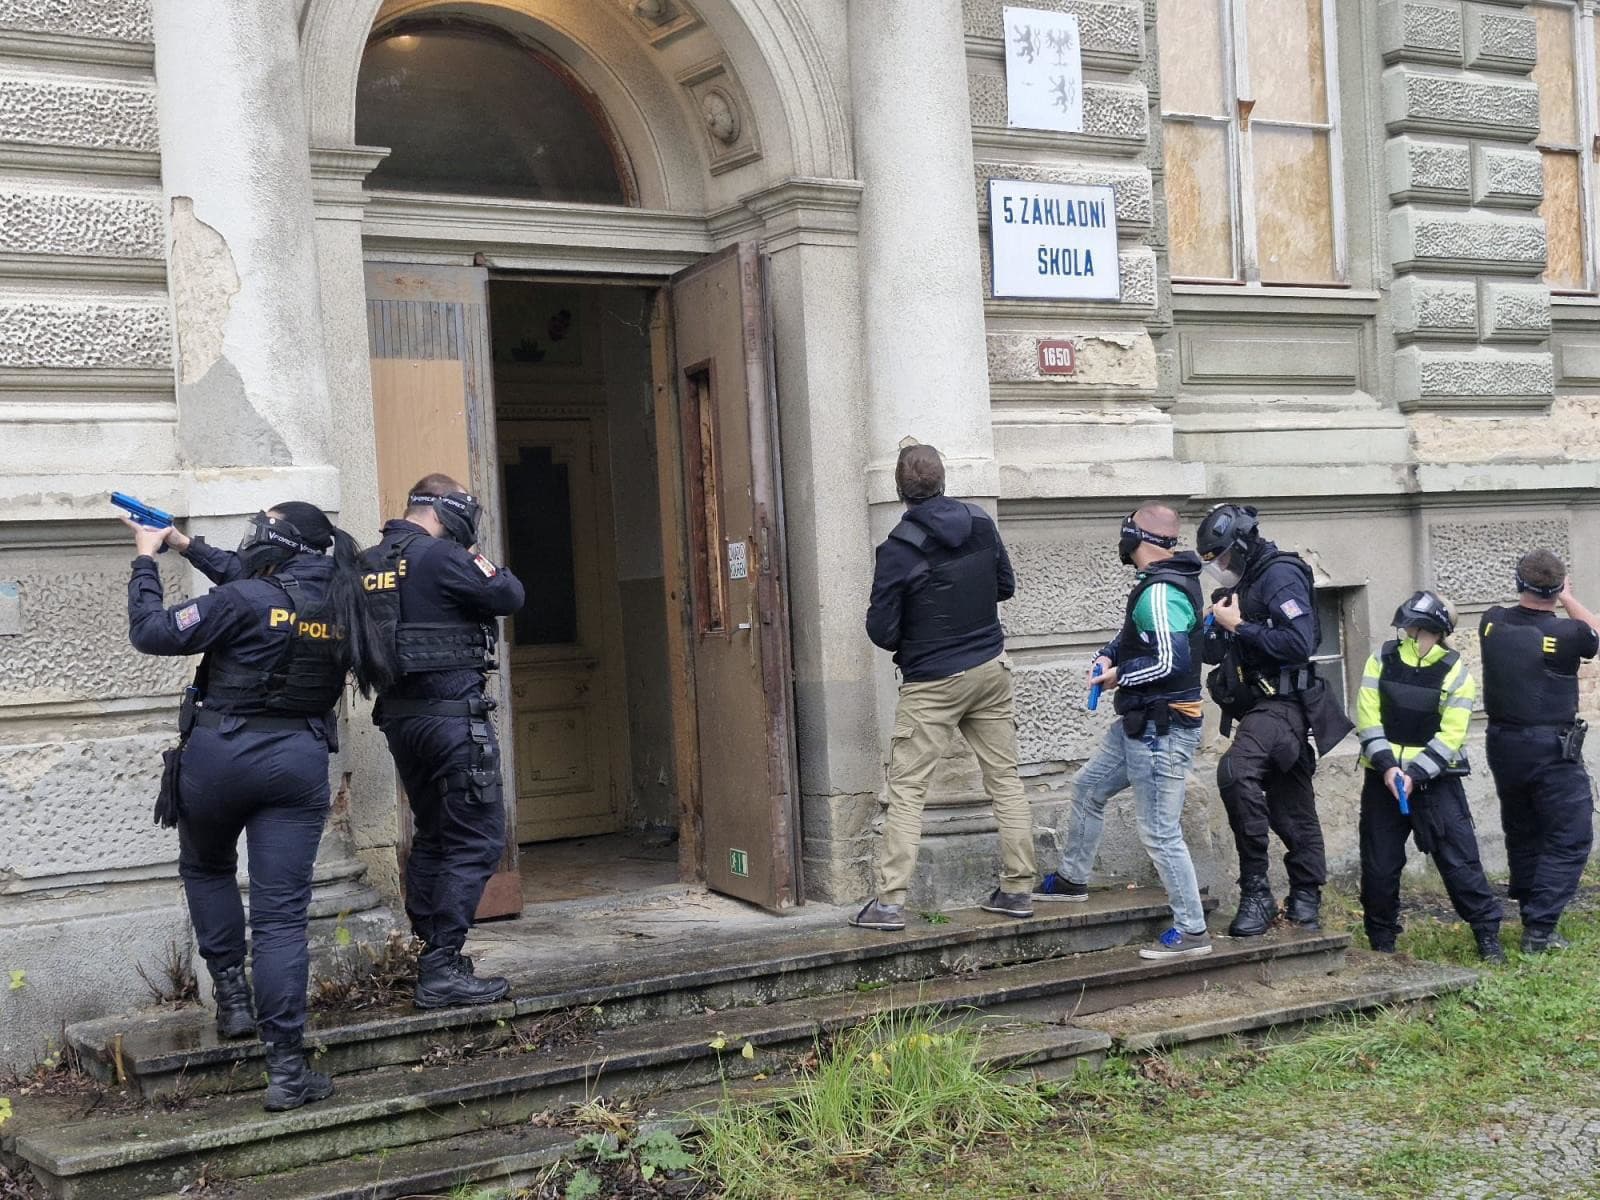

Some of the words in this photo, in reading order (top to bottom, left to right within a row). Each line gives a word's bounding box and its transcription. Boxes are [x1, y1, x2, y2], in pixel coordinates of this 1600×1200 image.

[1038, 244, 1094, 277] ŠKOLA
[1042, 347, 1071, 367] 1650
[361, 571, 396, 591] CIE
